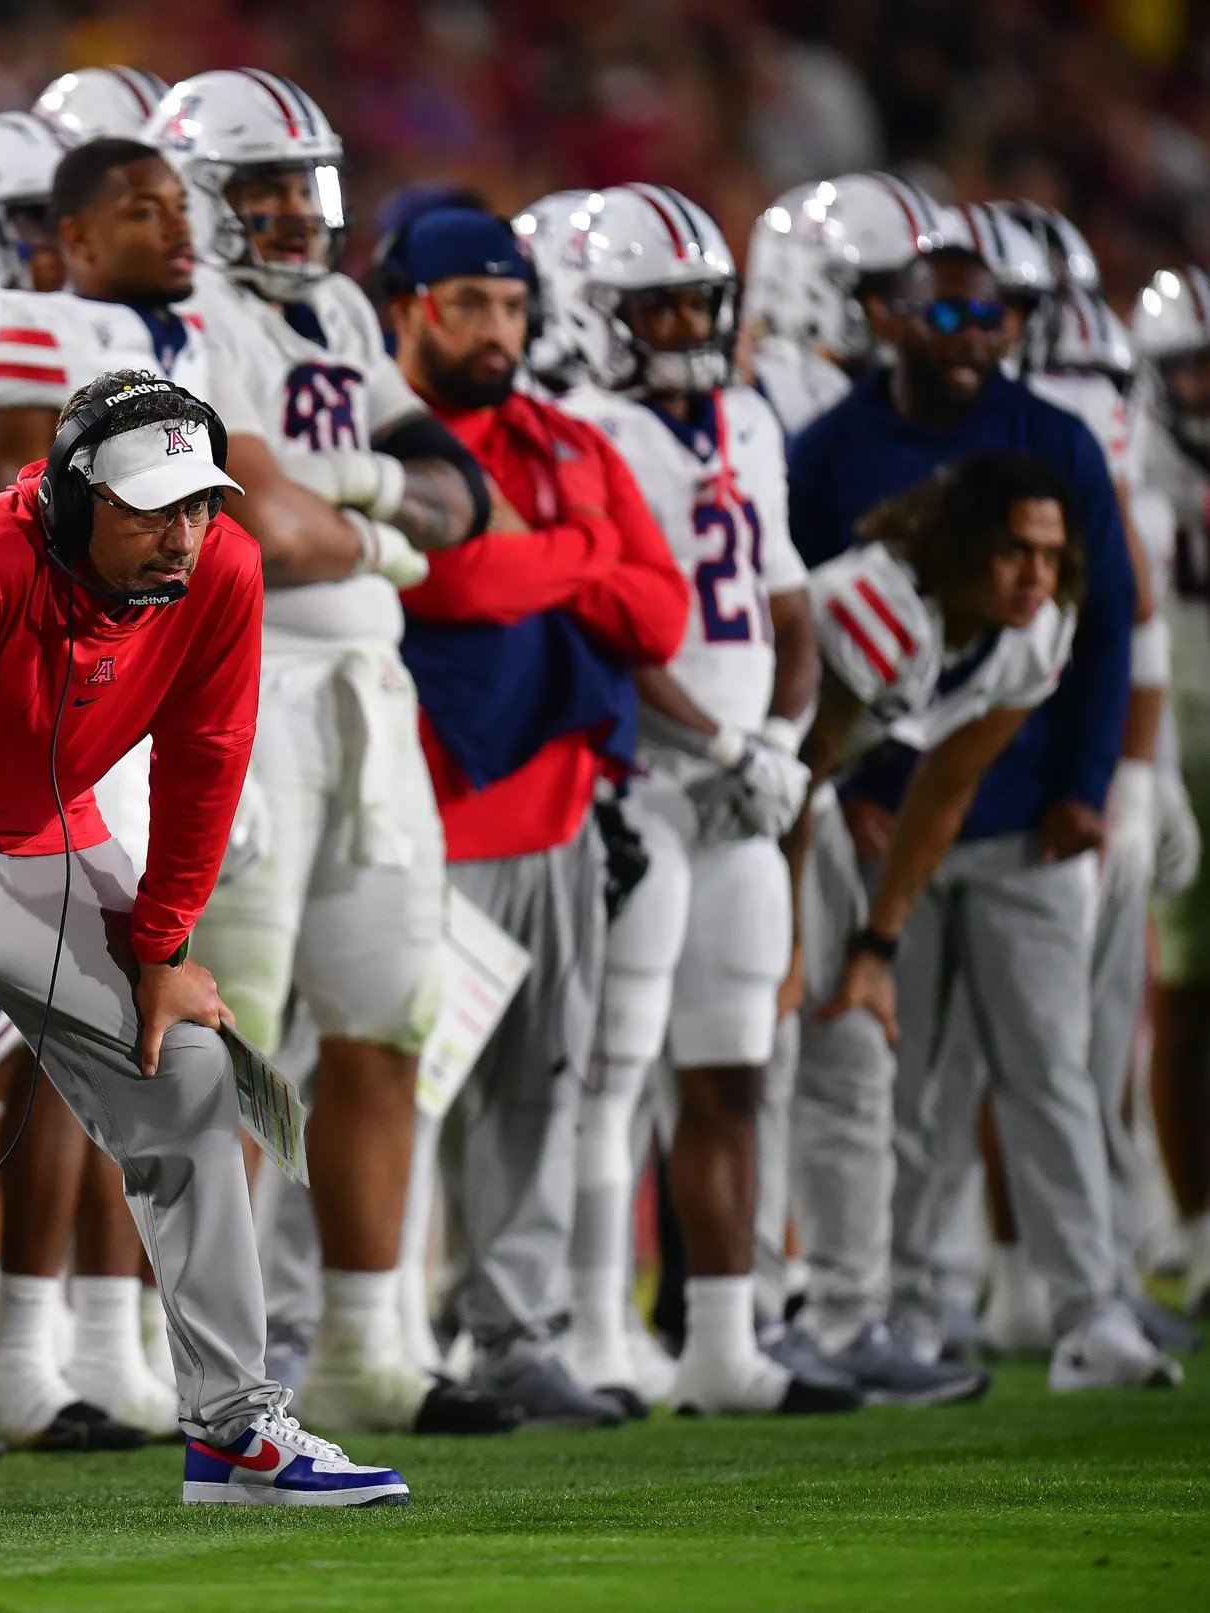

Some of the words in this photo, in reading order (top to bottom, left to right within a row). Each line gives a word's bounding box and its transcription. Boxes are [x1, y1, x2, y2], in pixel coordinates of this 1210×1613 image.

[104, 383, 172, 407] nextiva
[163, 427, 193, 456] A
[85, 656, 118, 685] A
